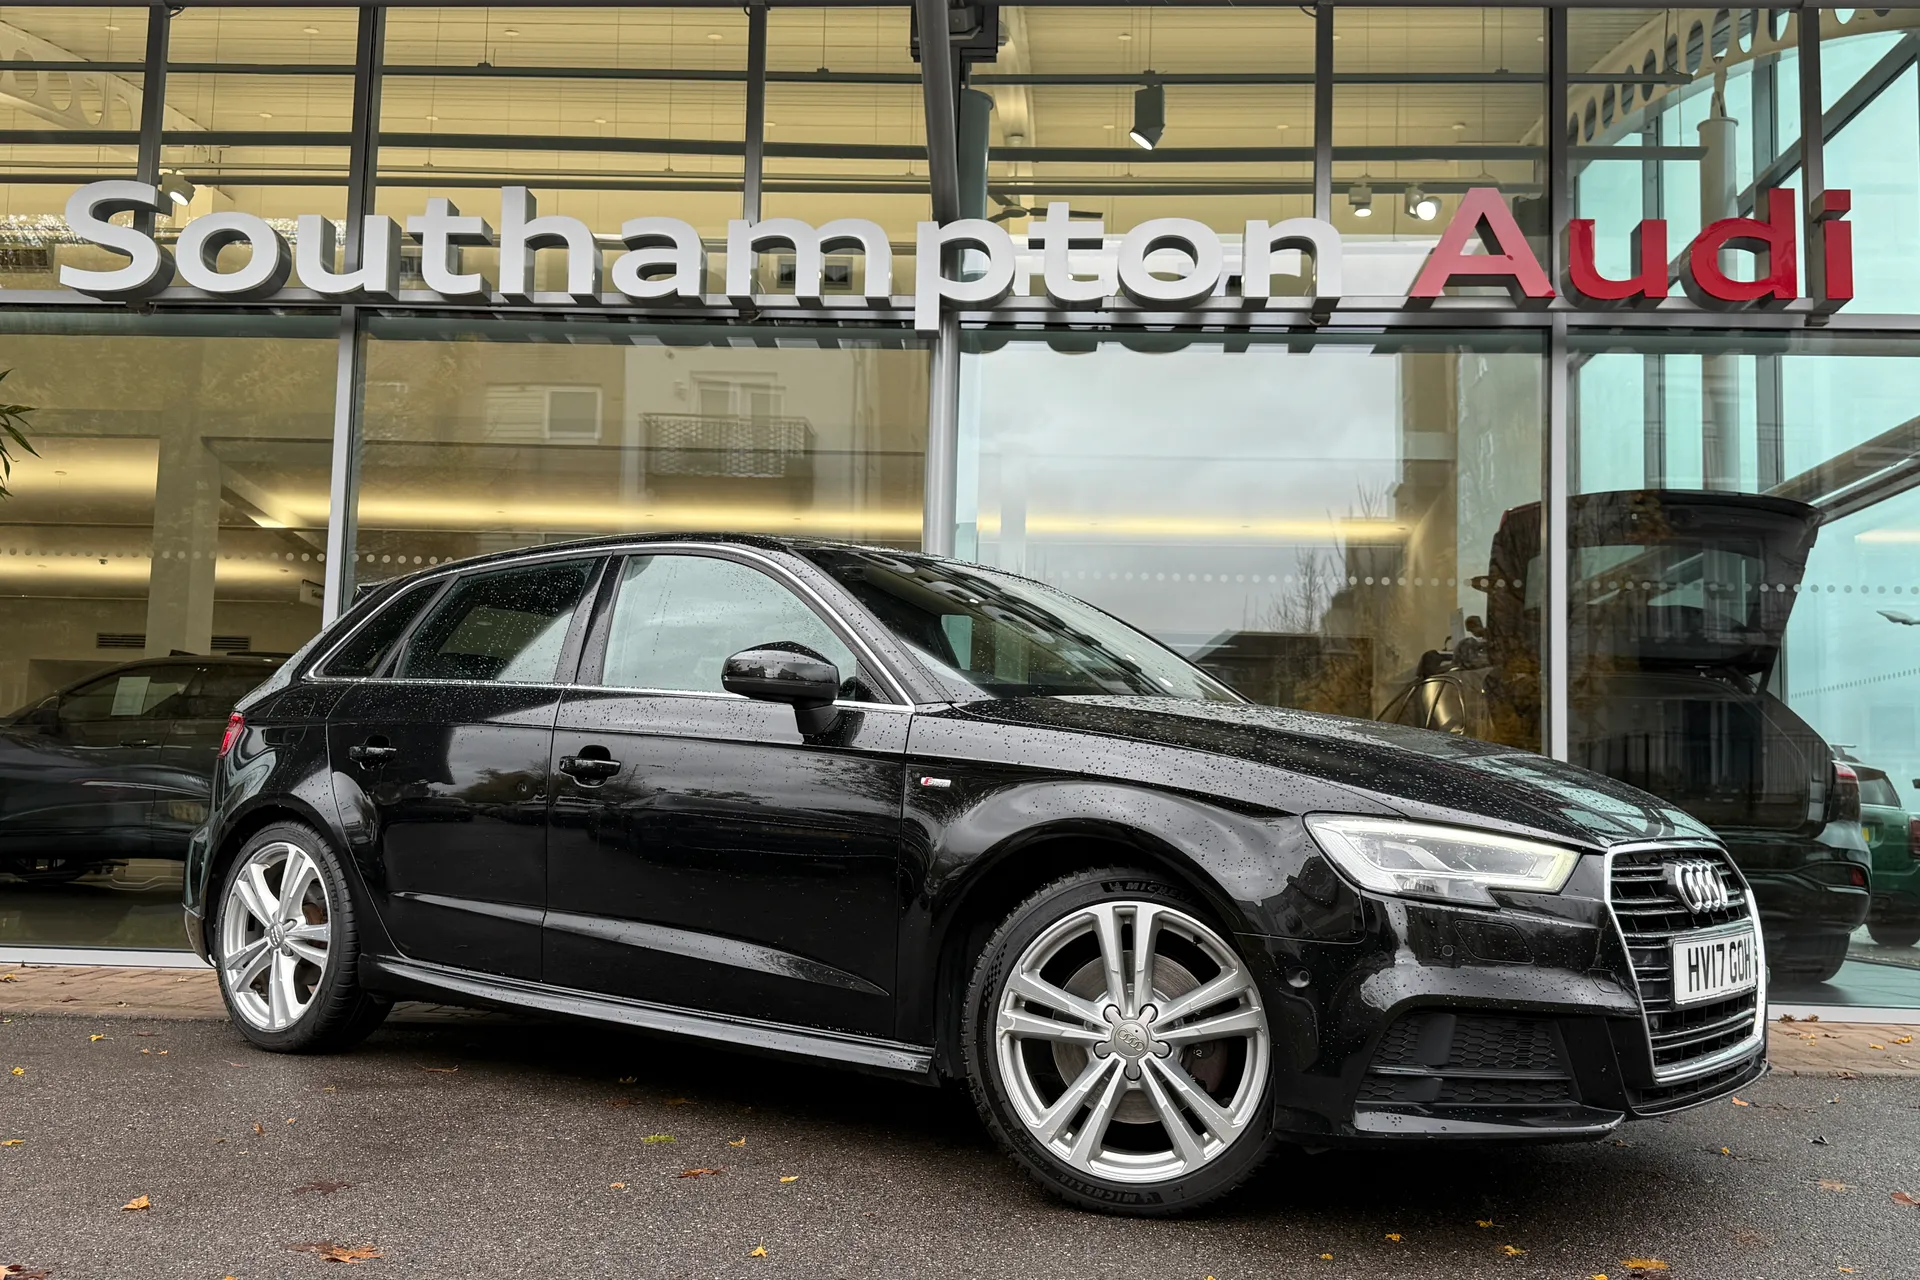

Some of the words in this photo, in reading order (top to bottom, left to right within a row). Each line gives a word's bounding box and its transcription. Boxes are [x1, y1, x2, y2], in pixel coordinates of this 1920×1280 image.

[60, 180, 1343, 332] Southampton
[1408, 187, 1855, 301] Audi
[1126, 881, 1197, 905] MICHEL
[1687, 943, 1725, 993] HV17
[1729, 937, 1752, 984] GOH
